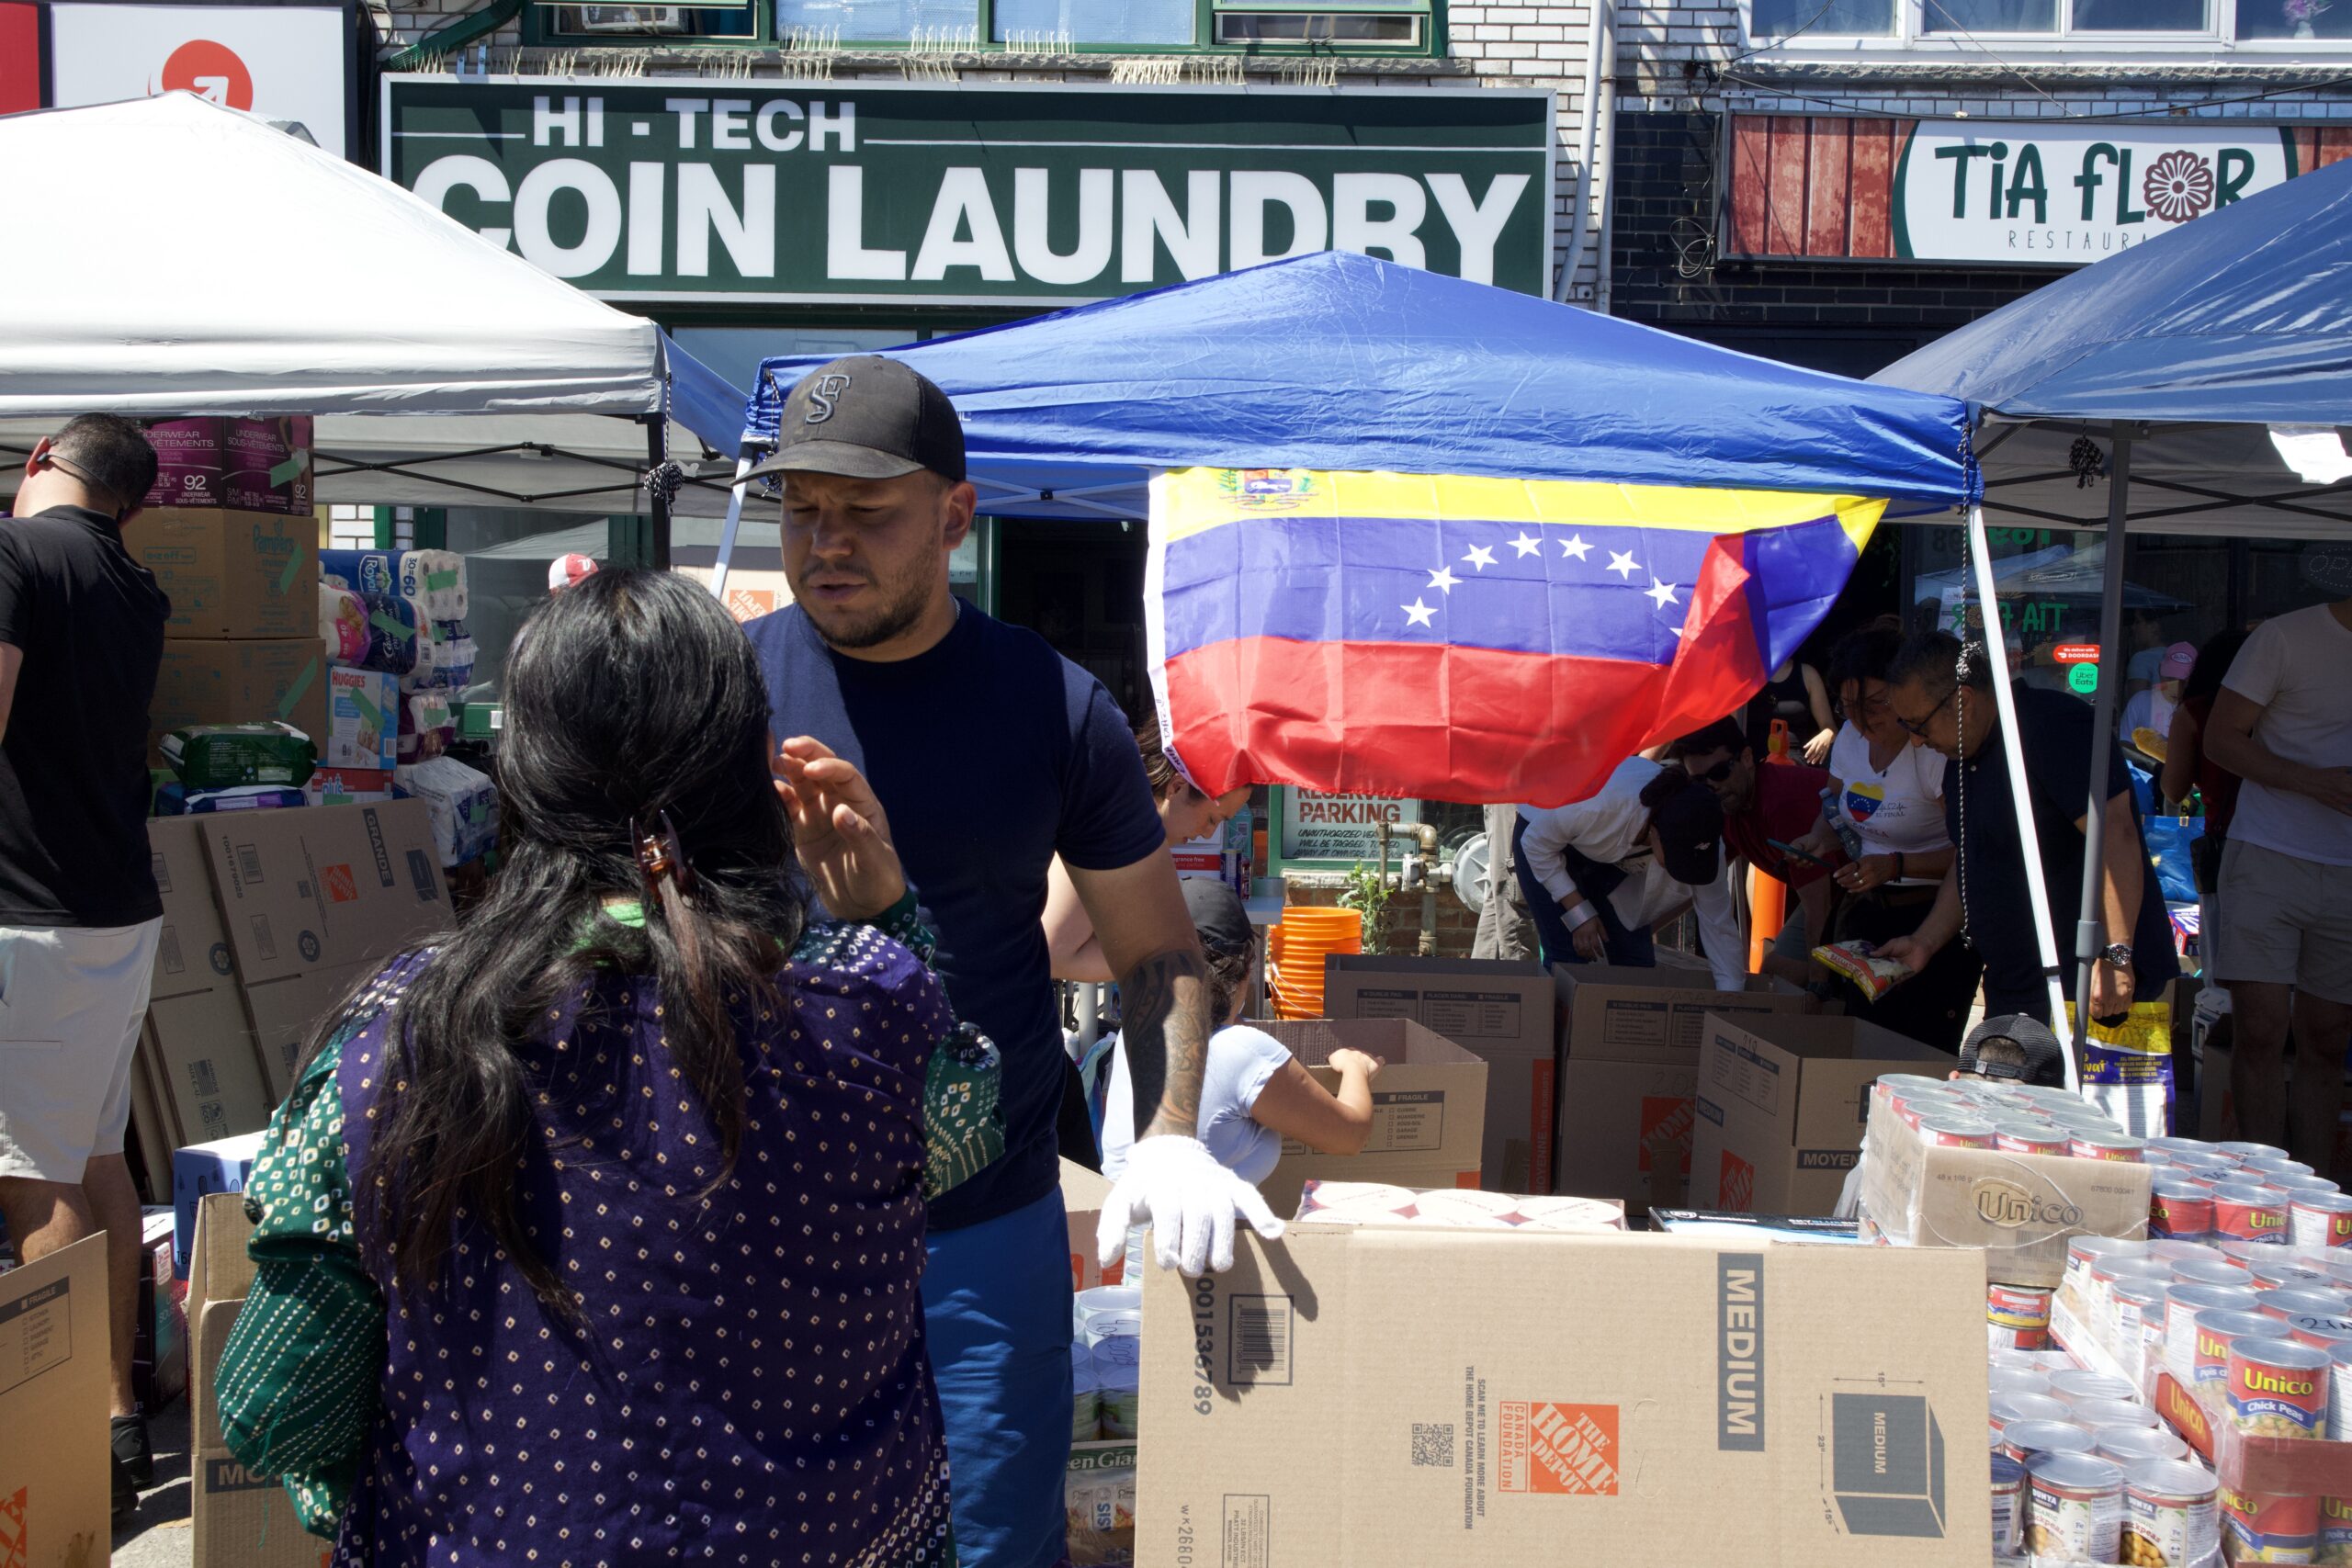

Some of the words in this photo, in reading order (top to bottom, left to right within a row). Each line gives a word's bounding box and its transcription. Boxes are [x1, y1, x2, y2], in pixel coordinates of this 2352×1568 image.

[534, 96, 604, 147] HI
[666, 97, 855, 152] TECH
[411, 154, 775, 278] COIN
[827, 164, 1532, 284] LAUNDRY
[235, 429, 277, 443] UNDERWEAR
[184, 474, 207, 491] 92
[295, 485, 306, 499] 92
[253, 524, 294, 554] Pampers
[332, 671, 366, 688] HUGGIES
[2075, 678, 2095, 686] Eats
[1299, 802, 1401, 824] PARKING
[1297, 829, 1363, 839] UNAUTHORIZED
[1299, 840, 1318, 848] WILL
[1321, 840, 1334, 848] BE
[367, 814, 391, 882] GRANDE
[1804, 1153, 1860, 1166] MOYEN
[1977, 1190, 2084, 1225] Unico
[29, 1286, 56, 1305] FRAGILE
[1726, 1269, 1757, 1435] MEDIUM
[1464, 1366, 1474, 1382] THE
[2244, 1367, 2313, 1396] Unico
[1464, 1383, 1474, 1408] HOME
[1476, 1379, 1486, 1402] SCAN
[1476, 1404, 1486, 1417] ME
[2170, 1382, 2204, 1435] Unico
[2247, 1401, 2276, 1412] Chick
[2279, 1402, 2304, 1423] Peas
[1464, 1411, 1474, 1437] DEPOT
[1476, 1419, 1486, 1430] TO
[1514, 1405, 1524, 1458] CANADA
[1574, 1413, 1611, 1452] THE
[1476, 1432, 1486, 1460] LEARN
[1501, 1404, 1513, 1489] FOUNDATION
[1531, 1403, 1619, 1495] HOME
[1873, 1412, 1887, 1473] MEDIUM
[1464, 1439, 1474, 1474] CANADA
[1531, 1438, 1586, 1495] DEPOT
[1476, 1462, 1486, 1487] MORE
[1464, 1477, 1474, 1529] FOUNDATION
[1476, 1489, 1486, 1517] ABOUT
